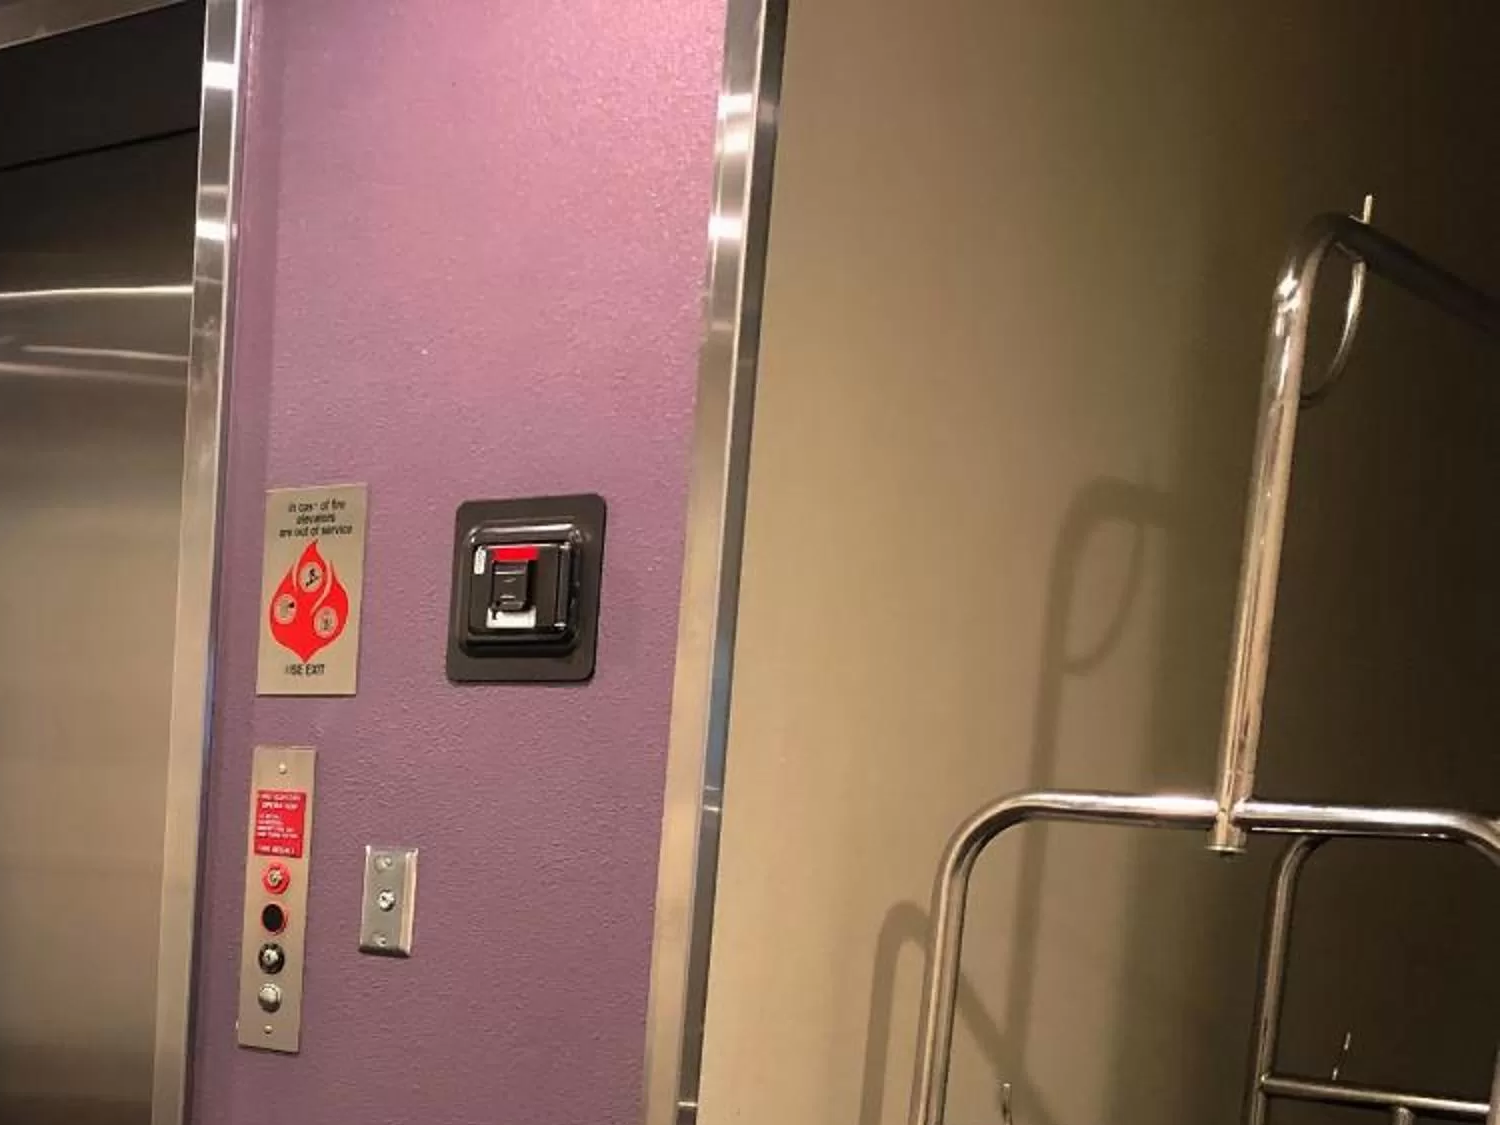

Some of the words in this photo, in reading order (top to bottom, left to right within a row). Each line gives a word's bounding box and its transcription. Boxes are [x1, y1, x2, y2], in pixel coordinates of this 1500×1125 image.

[296, 513, 336, 525] elevators
[279, 528, 292, 537] are
[294, 527, 308, 537] out
[310, 526, 319, 536] of
[321, 524, 353, 536] service
[305, 663, 325, 676] EXIT
